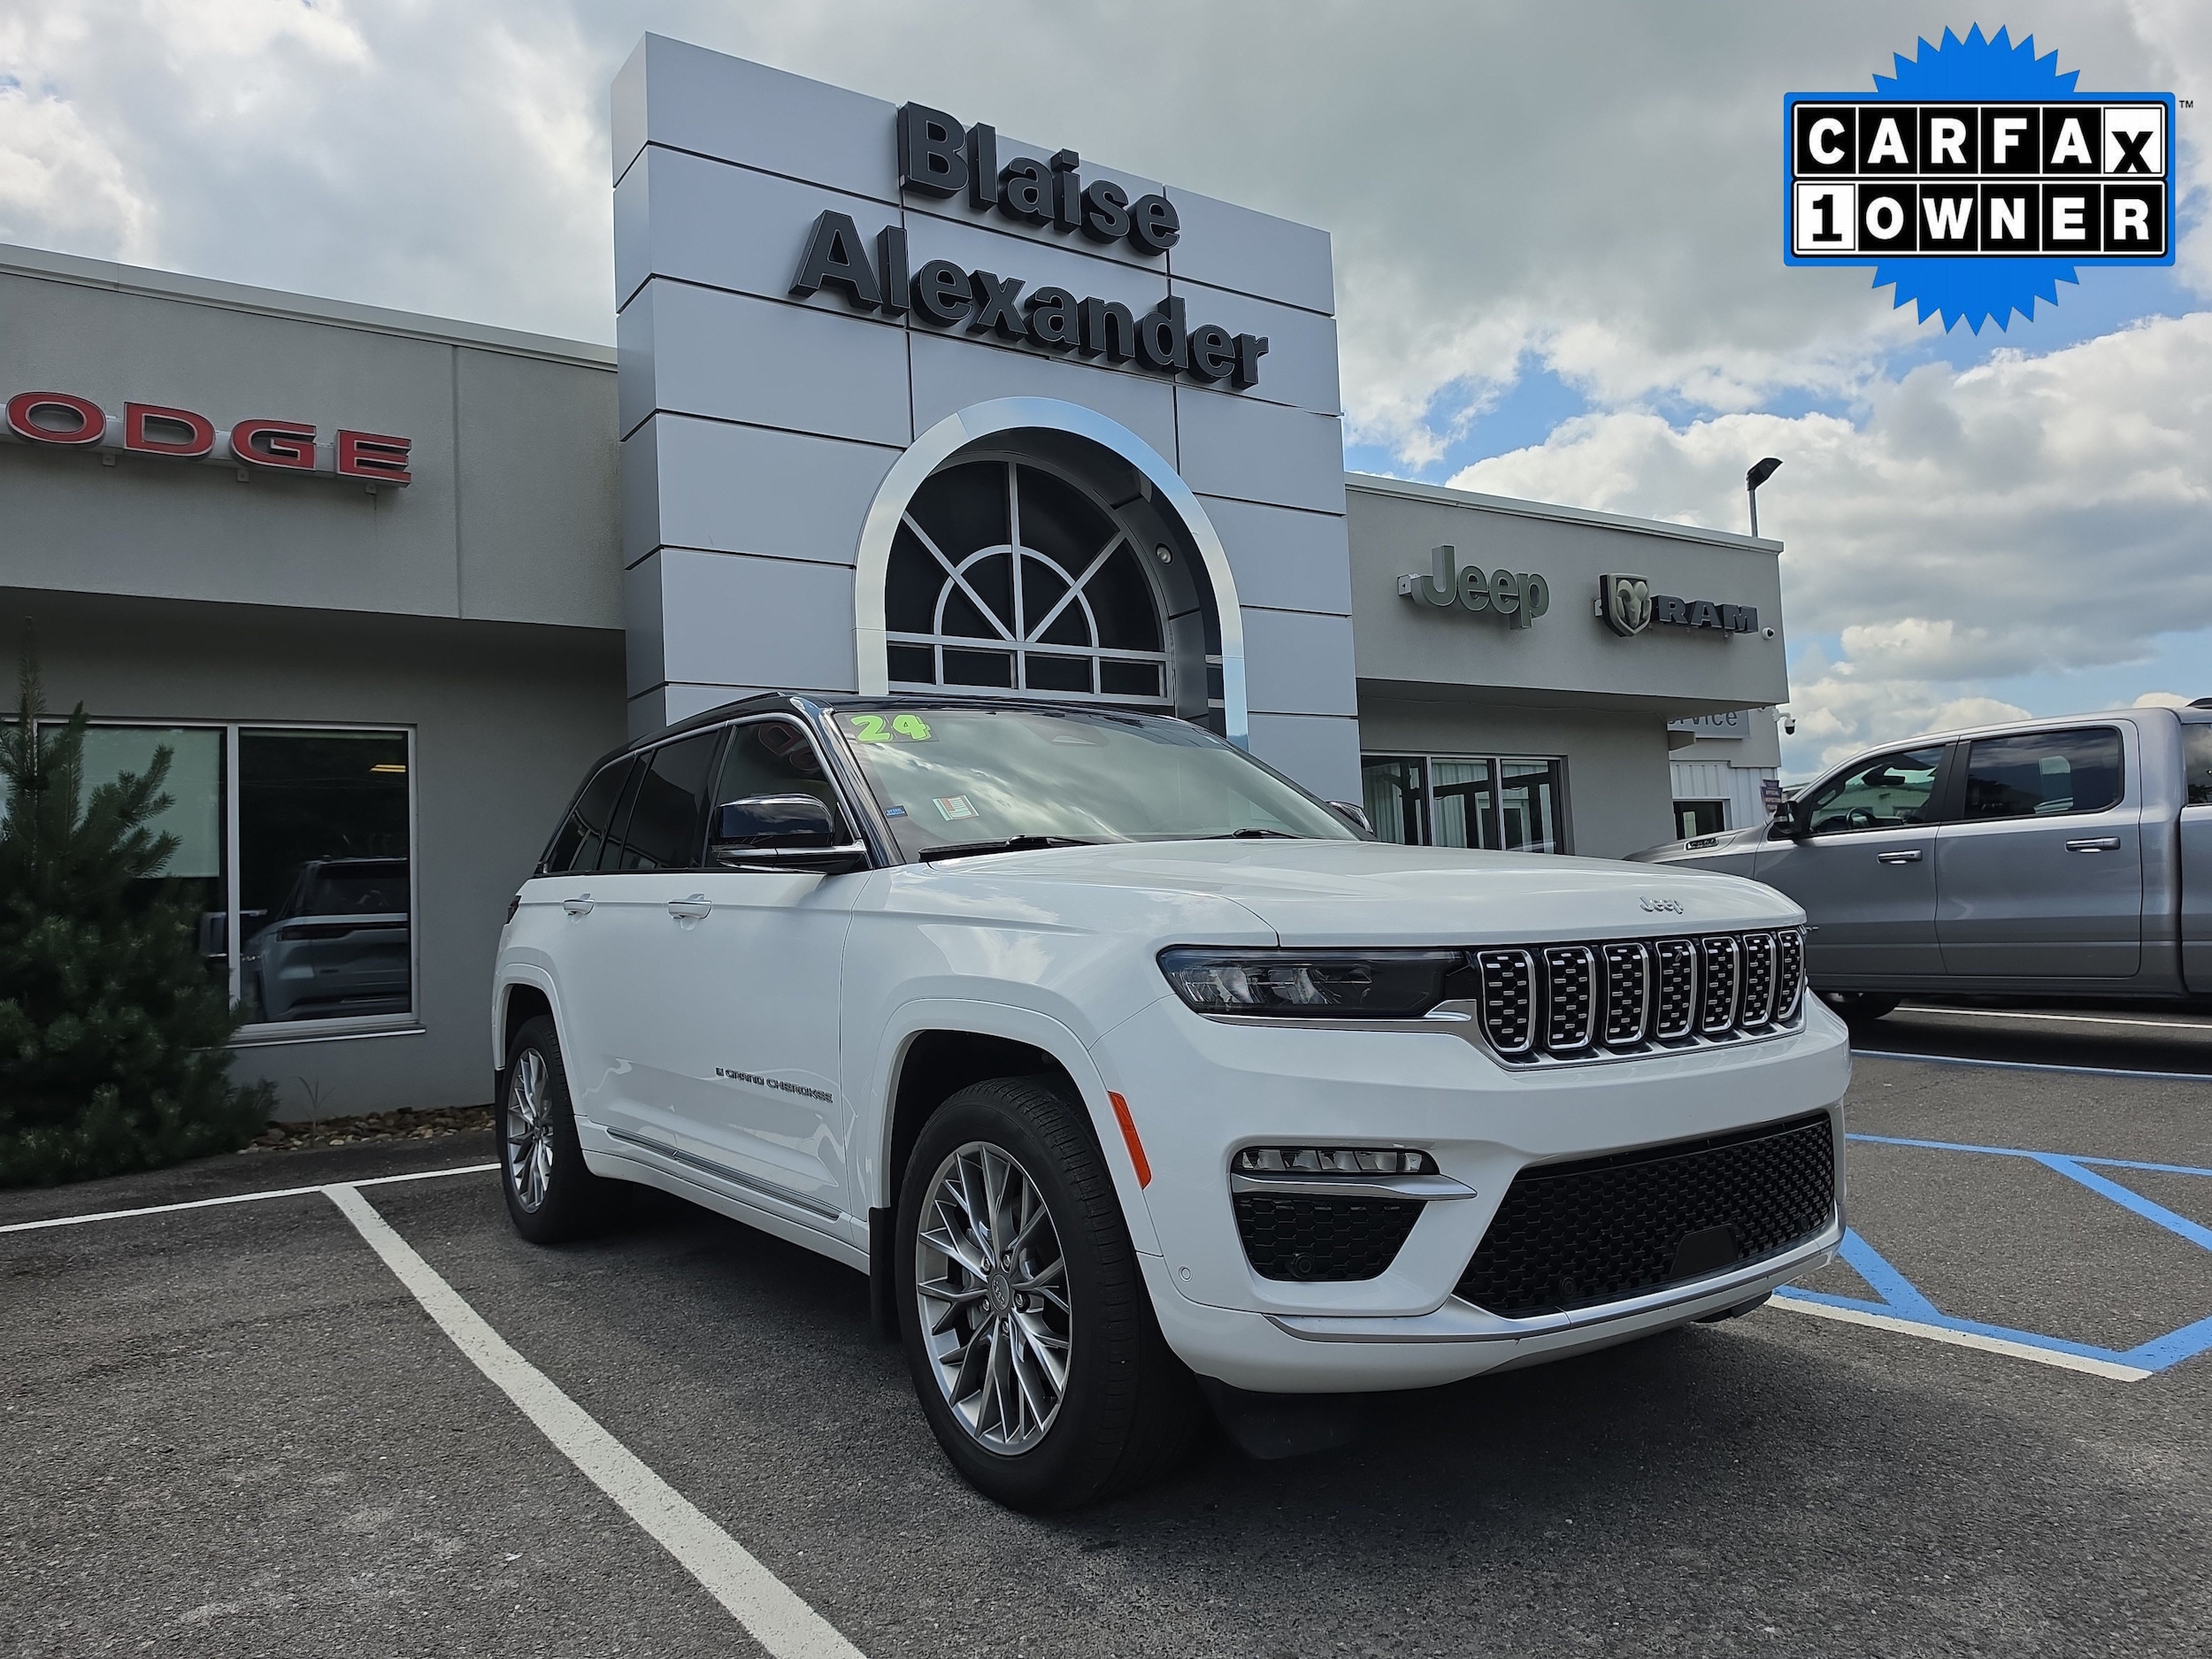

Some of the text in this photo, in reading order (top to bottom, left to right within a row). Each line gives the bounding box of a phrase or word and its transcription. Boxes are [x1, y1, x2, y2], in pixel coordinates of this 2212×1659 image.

[898, 101, 1180, 257] Blaise
[788, 210, 1269, 390] Alexander
[1411, 544, 1550, 629] Jeep
[1654, 595, 1759, 634] RAM
[850, 714, 932, 741] 24
[1639, 895, 1684, 915] Jeep
[725, 1069, 833, 1103] GRAND CHEROKEE
